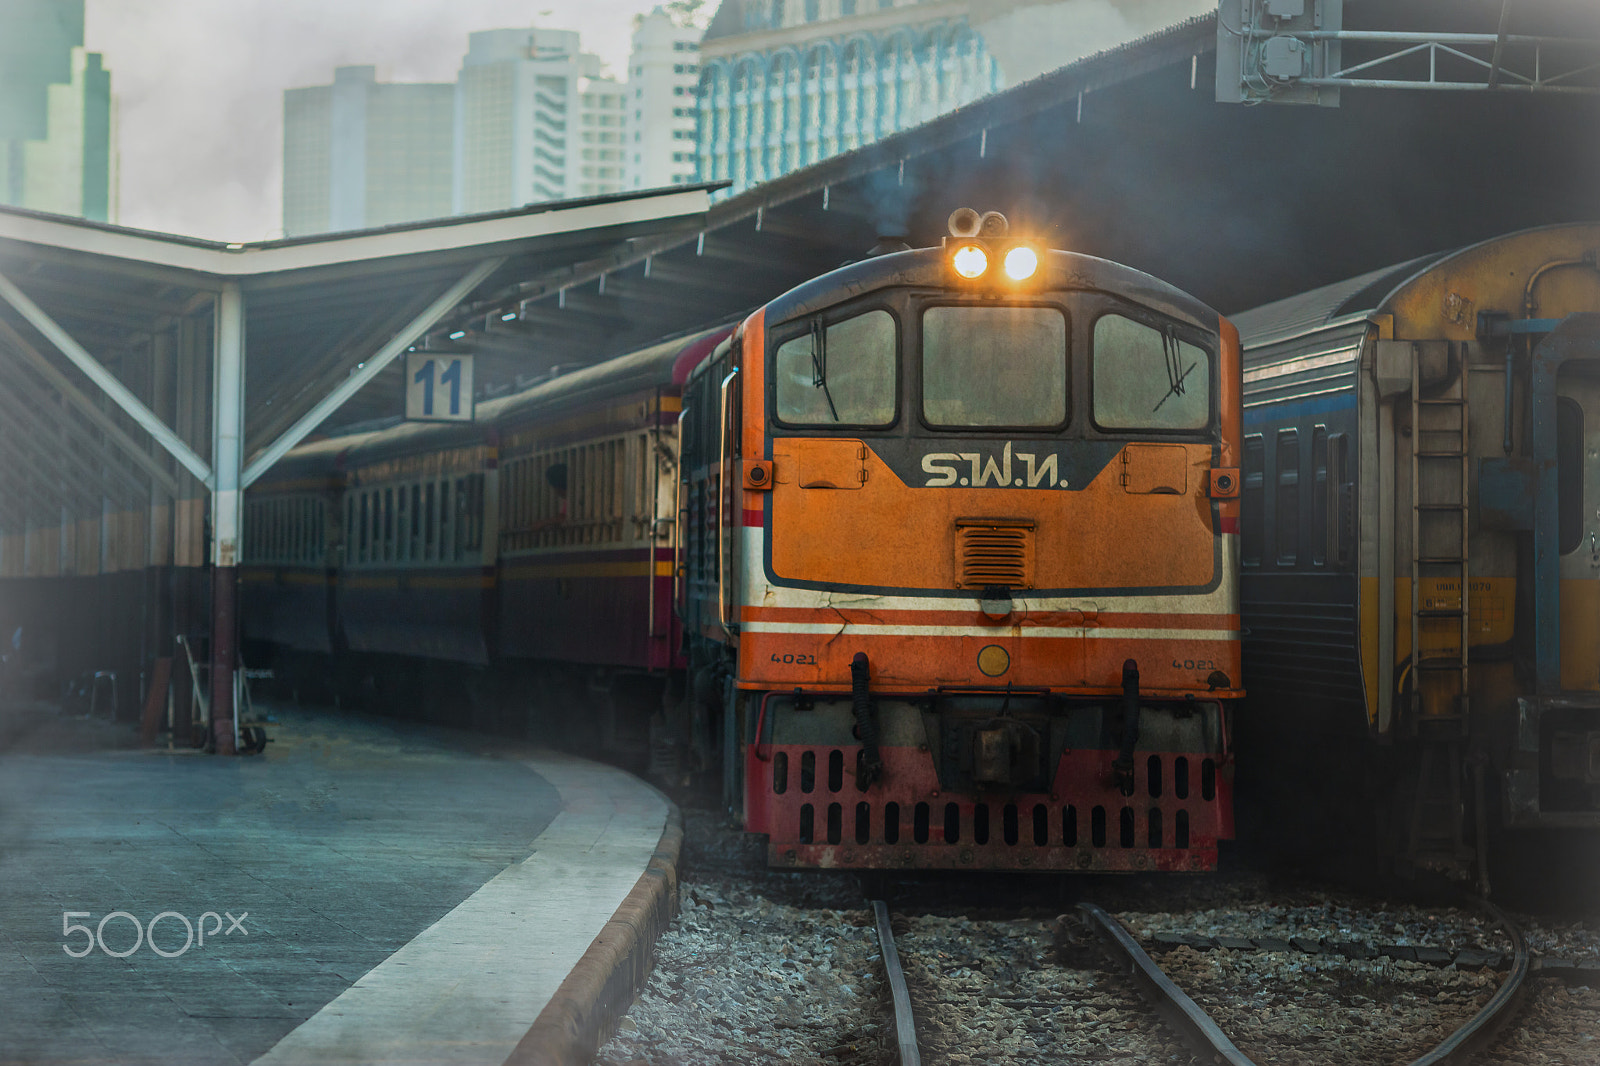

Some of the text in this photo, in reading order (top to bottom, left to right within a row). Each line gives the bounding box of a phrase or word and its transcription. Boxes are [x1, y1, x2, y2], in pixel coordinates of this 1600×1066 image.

[414, 360, 461, 415] 11
[921, 440, 1069, 488] ร.ฟ.ท.
[771, 653, 818, 665] 4021
[1172, 659, 1217, 671] 4021
